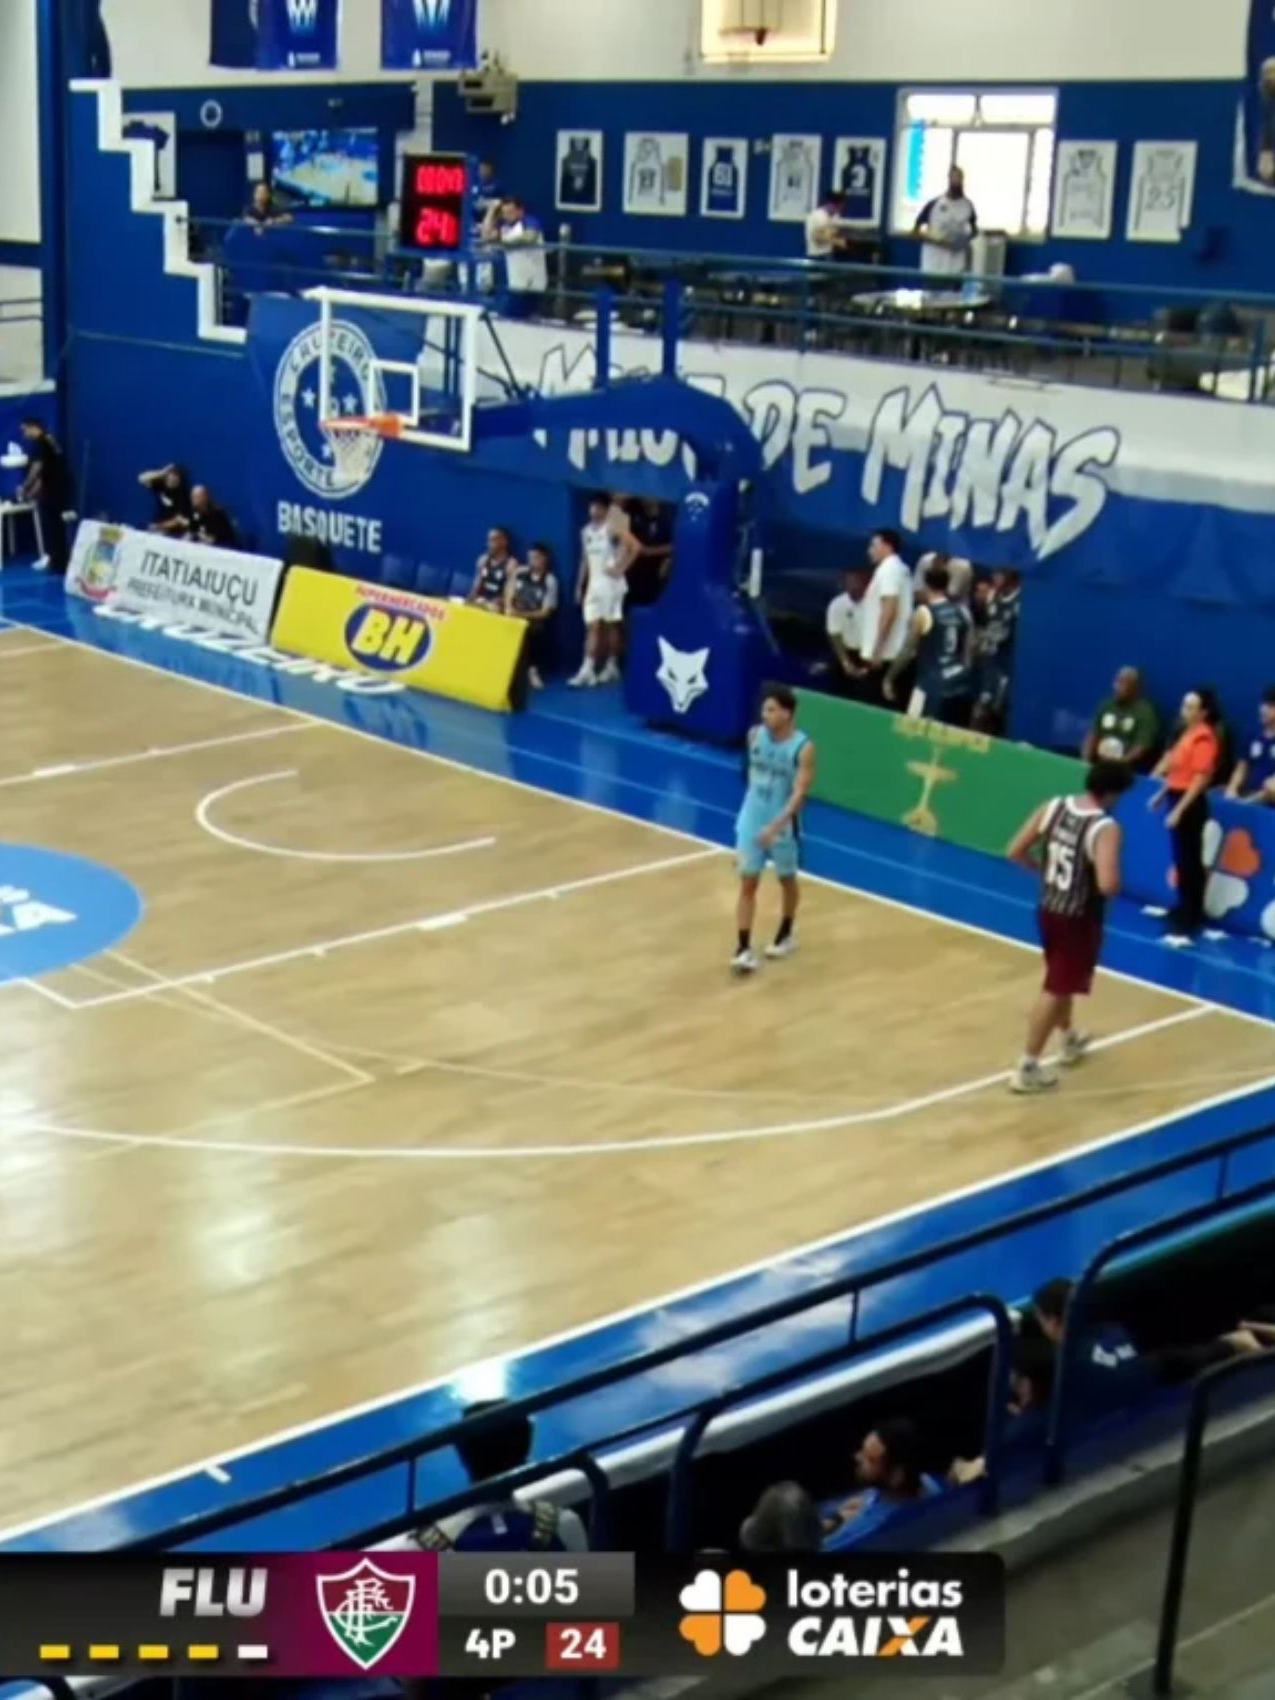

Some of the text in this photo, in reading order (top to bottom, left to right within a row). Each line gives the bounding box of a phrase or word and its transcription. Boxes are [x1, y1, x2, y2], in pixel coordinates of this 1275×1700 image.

[743, 379, 847, 495] DE
[861, 382, 1121, 561] MINAS
[277, 500, 382, 555] BASQUETE
[140, 550, 259, 612] ITATIAIUÇU
[351, 607, 426, 666] BH
[1046, 840, 1076, 891] 15
